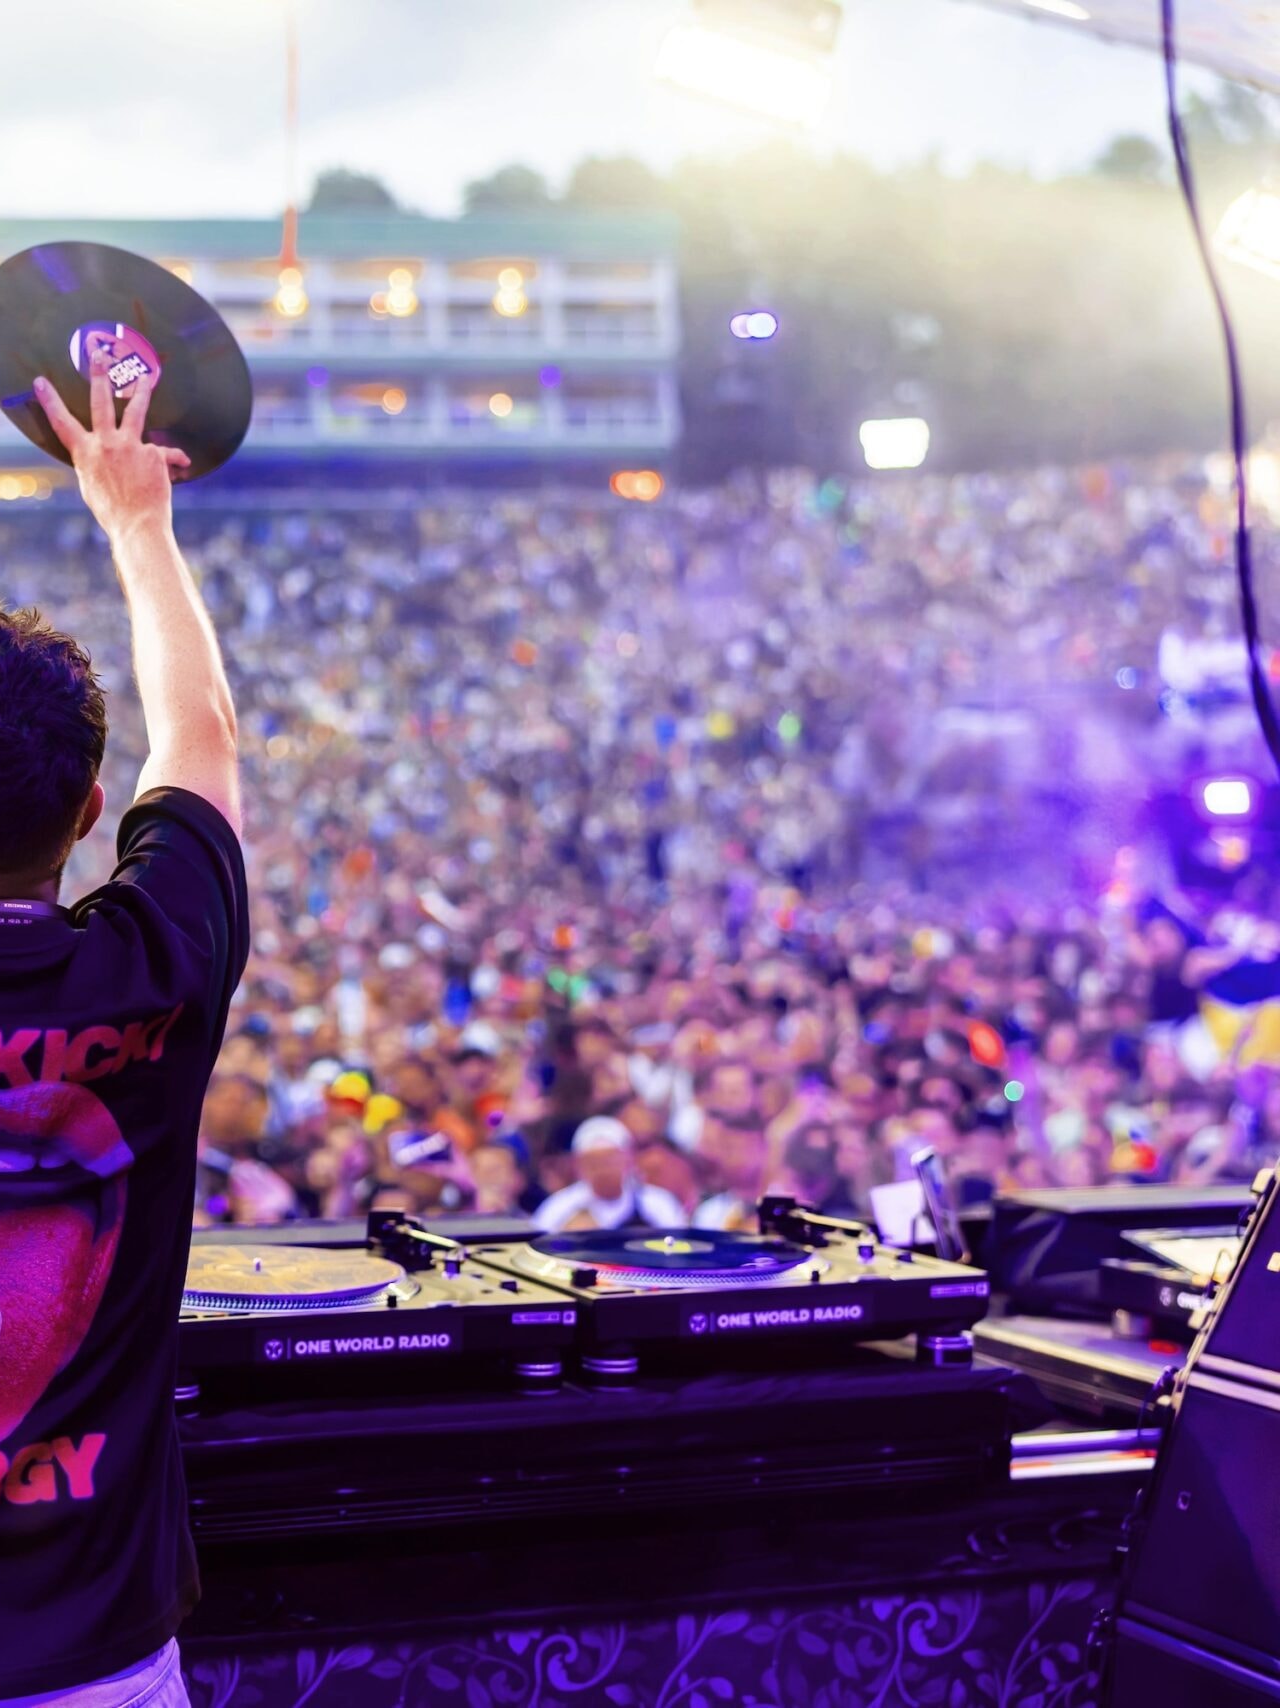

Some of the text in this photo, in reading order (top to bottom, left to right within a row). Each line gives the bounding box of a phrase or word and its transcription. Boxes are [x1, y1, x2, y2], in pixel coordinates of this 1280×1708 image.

[716, 1305, 862, 1328] ONE WORLD RADIO
[295, 1333, 450, 1354] ONE WORLD RADIO
